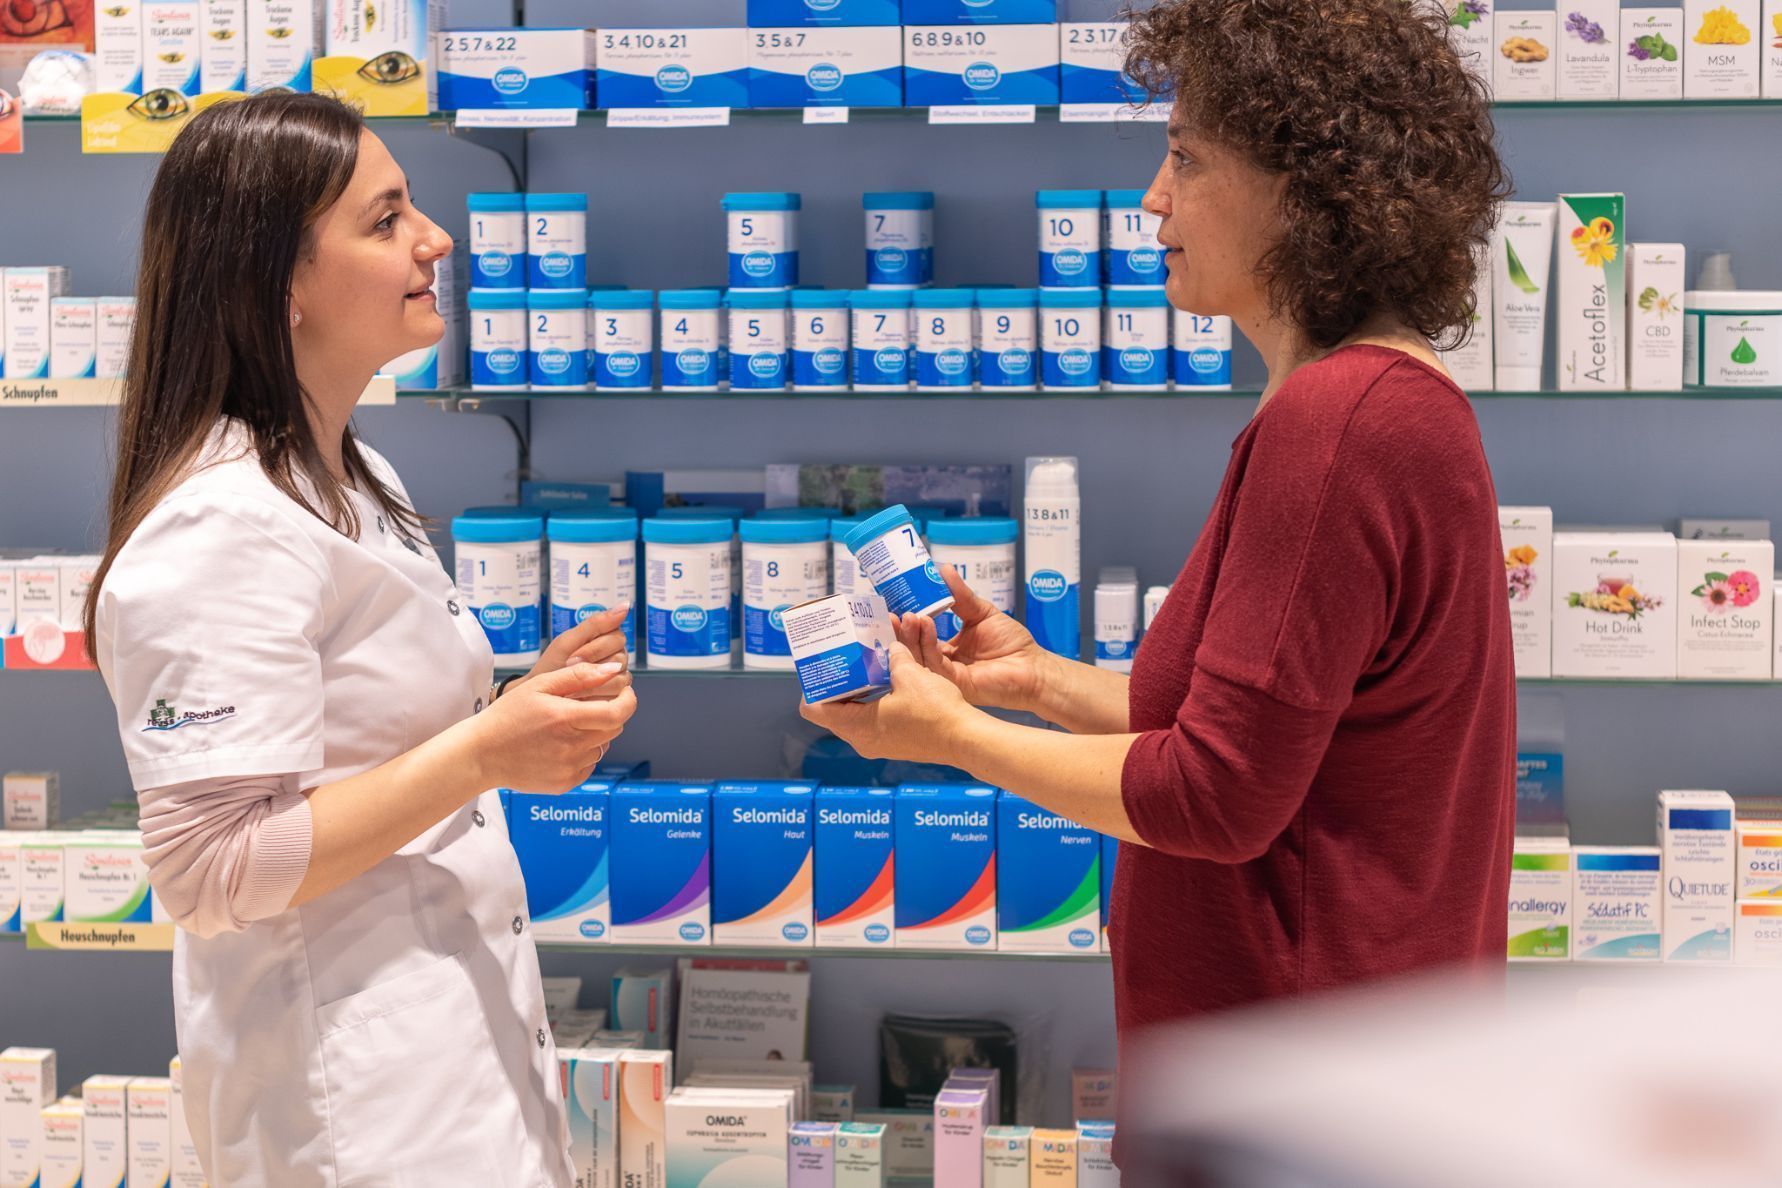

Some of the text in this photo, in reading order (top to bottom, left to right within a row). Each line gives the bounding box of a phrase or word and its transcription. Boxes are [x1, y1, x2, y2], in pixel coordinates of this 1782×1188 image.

[495, 37, 516, 51] 22
[669, 34, 687, 48] 21
[771, 34, 781, 47] 5
[796, 33, 806, 47] 7
[966, 31, 986, 46] 10
[1566, 53, 1610, 63] Lavandula
[1708, 56, 1736, 66] MSM
[1511, 66, 1538, 76] Ingwer
[1626, 64, 1678, 74] L-Tryptophan
[477, 221, 482, 238] 1
[537, 218, 548, 235] 2
[741, 219, 753, 236] 5
[875, 215, 886, 232] 7
[1050, 218, 1074, 236] 10
[1125, 214, 1141, 232] 11
[1506, 303, 1540, 313] Aloe Vera
[484, 319, 491, 335] 1
[537, 315, 548, 332] 2
[606, 319, 617, 336] 3
[675, 318, 689, 335] 4
[748, 319, 760, 337] 5
[811, 316, 823, 334] 6
[875, 315, 886, 332] 7
[932, 317, 945, 335] 8
[997, 316, 1010, 333] 9
[1055, 319, 1080, 336] 10
[1118, 314, 1133, 332] 11
[1191, 316, 1214, 333] 12
[1646, 325, 1671, 337] CBD
[1583, 284, 1606, 383] Acetoflex
[2, 386, 58, 401] Schnupfen
[1059, 508, 1070, 519] 11
[902, 528, 914, 547] 7
[480, 560, 486, 576] 1
[577, 562, 591, 578] 4
[671, 563, 683, 579] 5
[767, 562, 779, 578] 8
[1032, 578, 1063, 588] OMIDA
[484, 609, 511, 619] OMIDA
[675, 610, 704, 622] OMIDA
[1691, 614, 1760, 630] Infect Stop
[1586, 620, 1643, 633] Hot Drink
[1018, 813, 1088, 829] Selomi
[560, 827, 602, 838] Erkältung
[667, 829, 702, 839] Gelenke
[784, 830, 805, 839] Haut
[854, 830, 889, 839] Muskeln
[951, 832, 988, 842] Muskeln
[1060, 835, 1092, 844] Nerven
[1635, 902, 1650, 917] PC
[61, 930, 135, 945] Heuschnupfen
[691, 987, 791, 1003] Homöopathische
[689, 1002, 798, 1021] Selbstbehandlung
[706, 1115, 744, 1126] OMIDA
